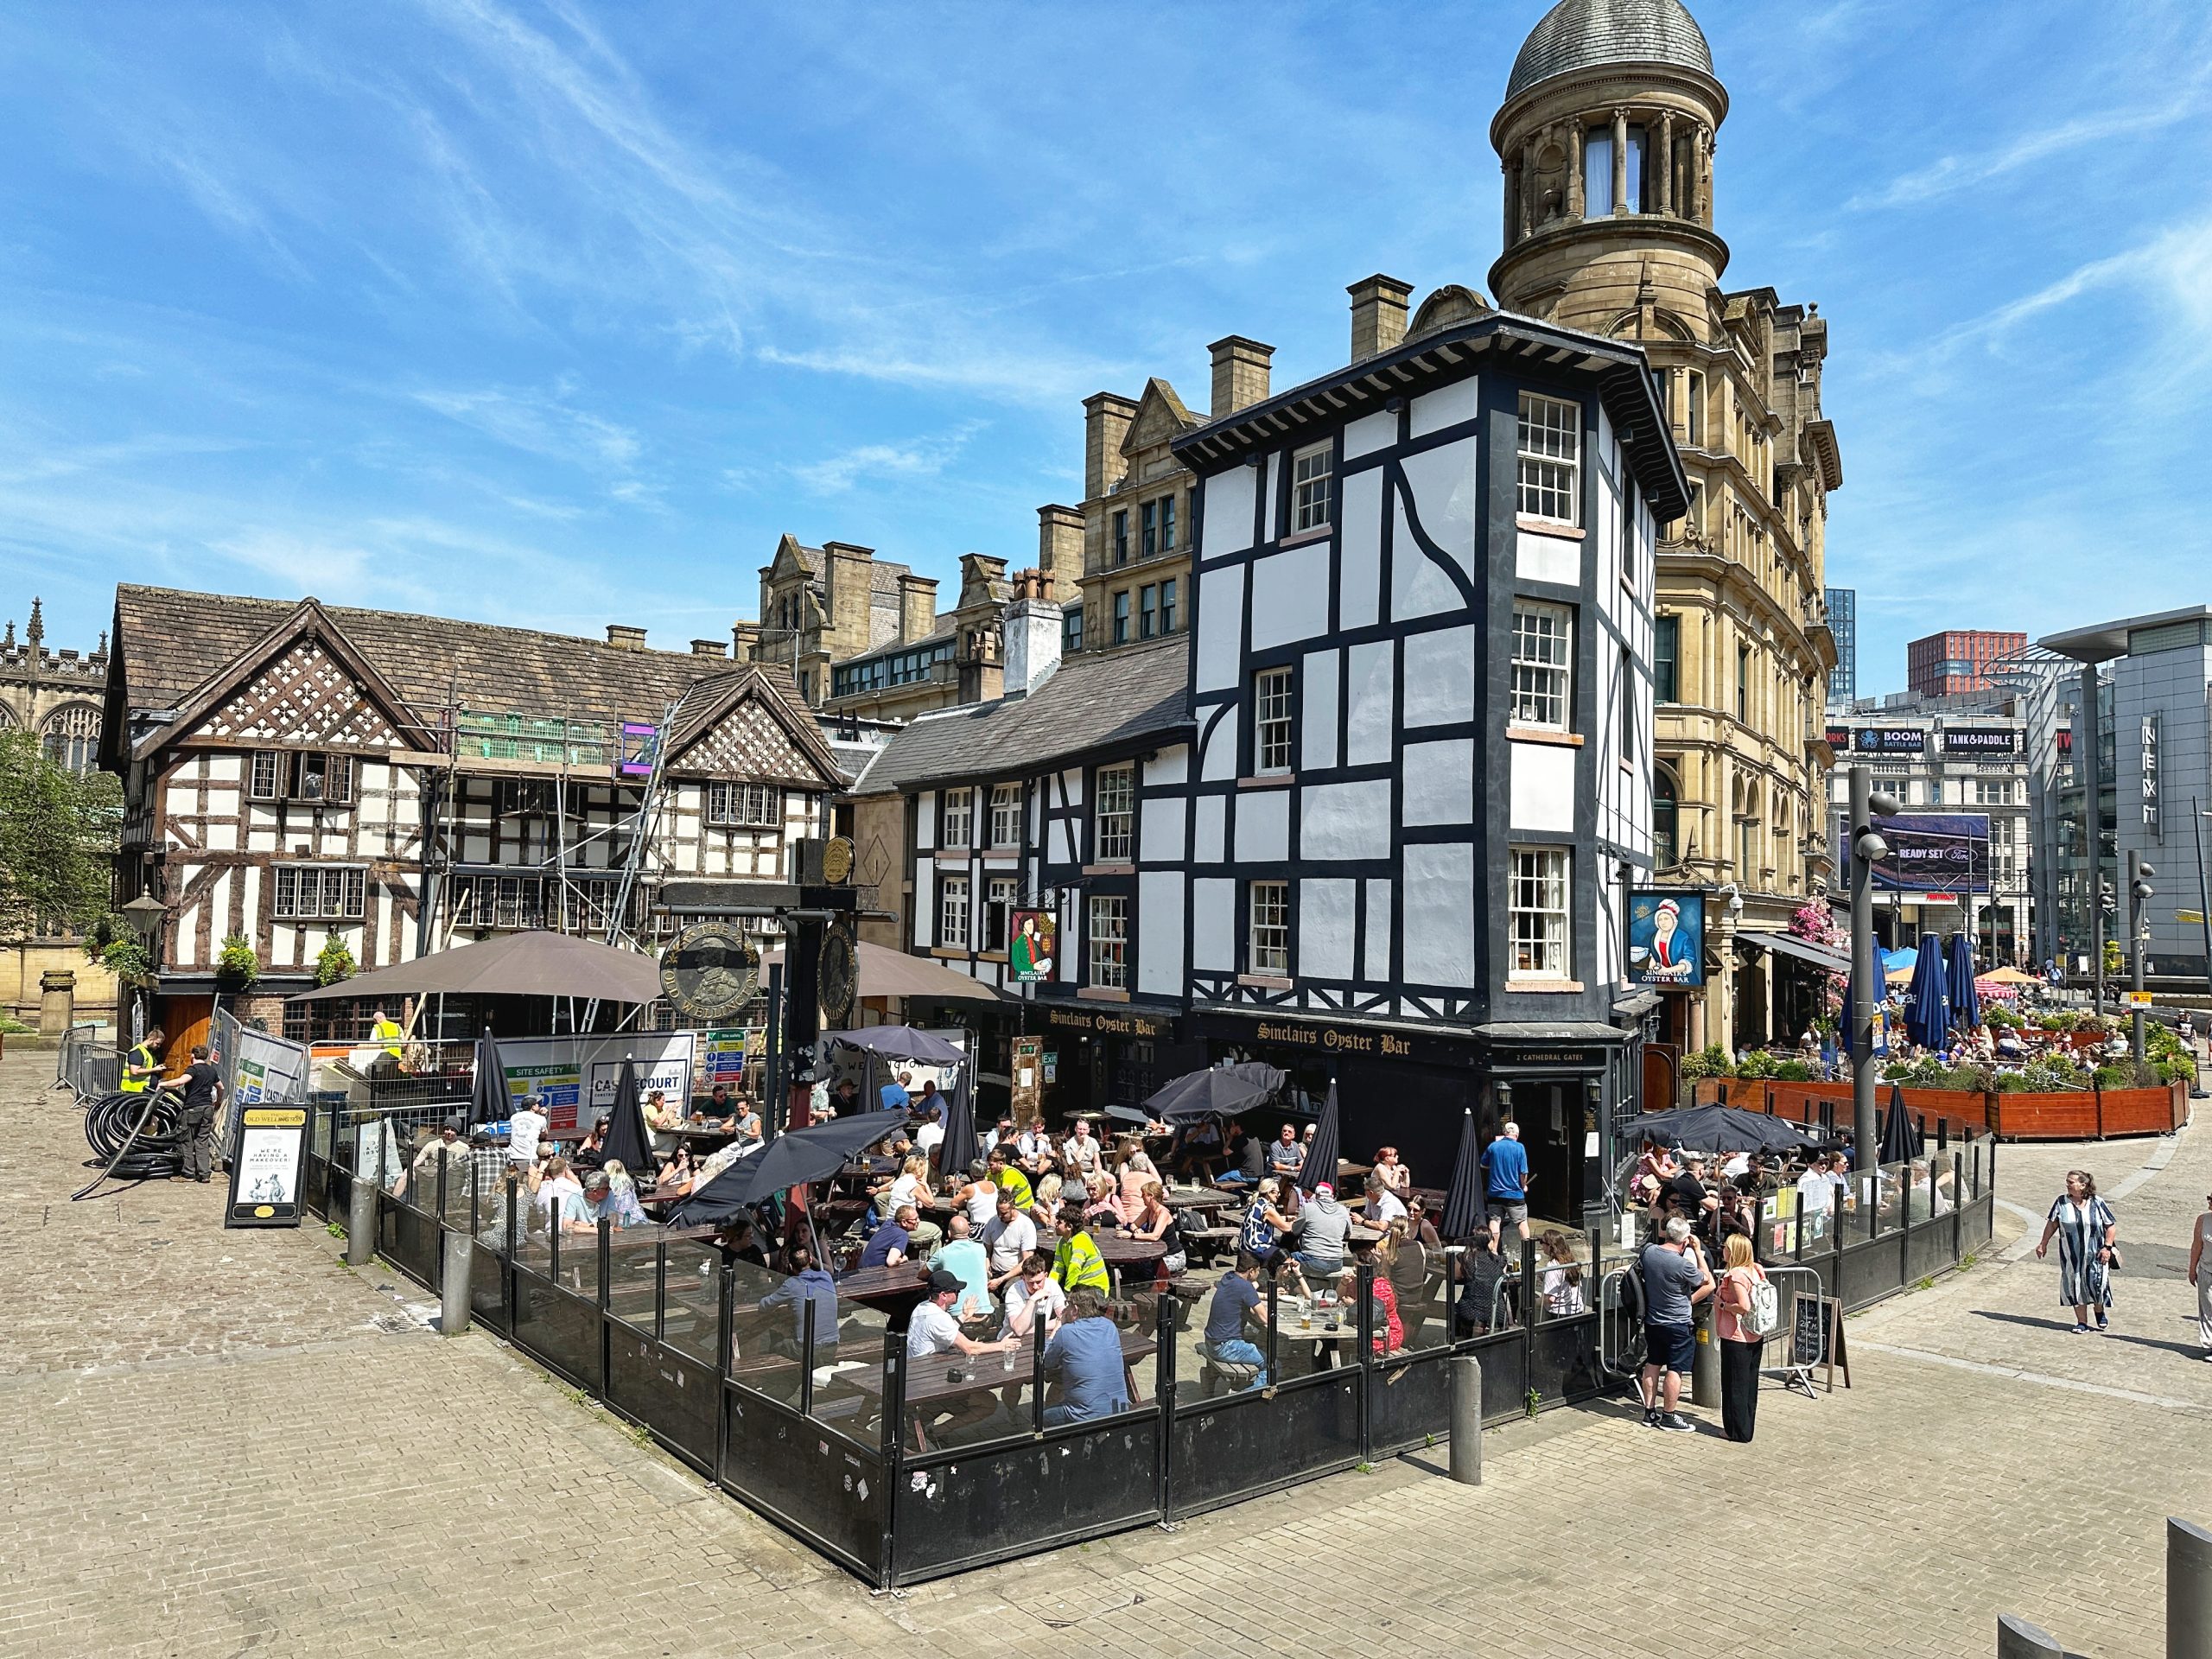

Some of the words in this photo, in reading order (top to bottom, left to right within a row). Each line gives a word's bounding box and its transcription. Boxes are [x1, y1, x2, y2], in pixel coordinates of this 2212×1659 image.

[1825, 732, 1847, 743] ORKS
[1884, 731, 1923, 741] BOOM
[1948, 734, 2011, 745] TANK&PADDLE
[2142, 726, 2157, 823] NEXT
[1899, 849, 1928, 859] READY
[1928, 849, 1944, 859] SET
[698, 924, 730, 936] THE
[830, 925, 844, 936] THE
[664, 969, 680, 999] OLD
[681, 969, 758, 1019] WELLINGTON
[1050, 1009, 1092, 1028] Sinclairs
[1096, 1014, 1130, 1033] Oyster
[1135, 1018, 1156, 1036] Bar
[1257, 1022, 1317, 1045] Sinclairs
[1324, 1029, 1373, 1052] Oyster
[1380, 1033, 1411, 1056] Bar
[1043, 1054, 1056, 1064] Exit
[848, 1060, 925, 1071] WELINGTON
[535, 1067, 564, 1076] SAFETY
[594, 1077, 679, 1092] CASECOURT
